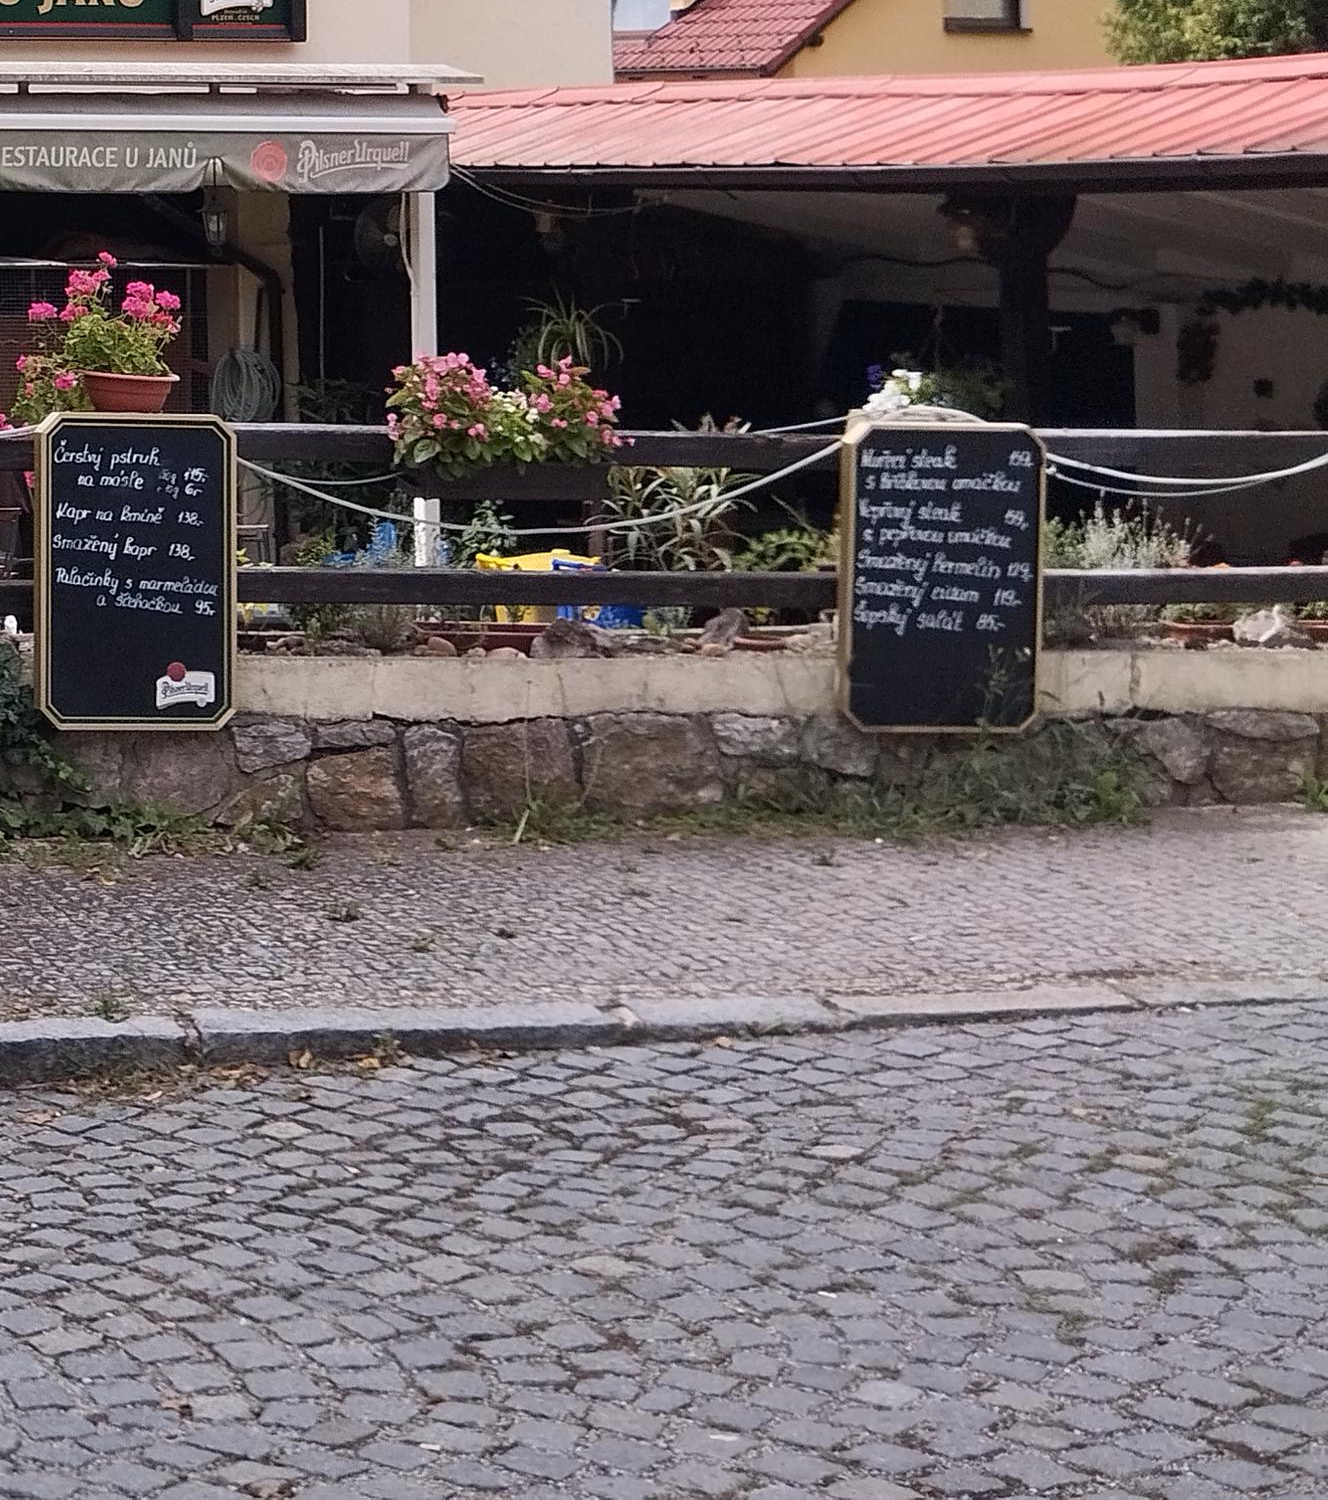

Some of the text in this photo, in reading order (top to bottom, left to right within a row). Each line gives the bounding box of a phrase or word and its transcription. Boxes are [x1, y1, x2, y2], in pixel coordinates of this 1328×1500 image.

[125, 147, 139, 168] U
[146, 141, 197, 169] JANŮ
[296, 139, 409, 182] Pilsner Urquell
[54, 439, 160, 471] Čerstvý pstruh
[77, 475, 94, 486] na
[99, 470, 144, 490] másle
[864, 474, 876, 490] s
[56, 502, 92, 525] Kapr
[95, 510, 114, 521] na
[120, 504, 165, 524] kmíně
[52, 533, 120, 560] Smažený
[123, 536, 158, 561] kapr
[55, 566, 120, 595] Palačinky
[125, 578, 133, 589] s
[96, 594, 107, 606] a
